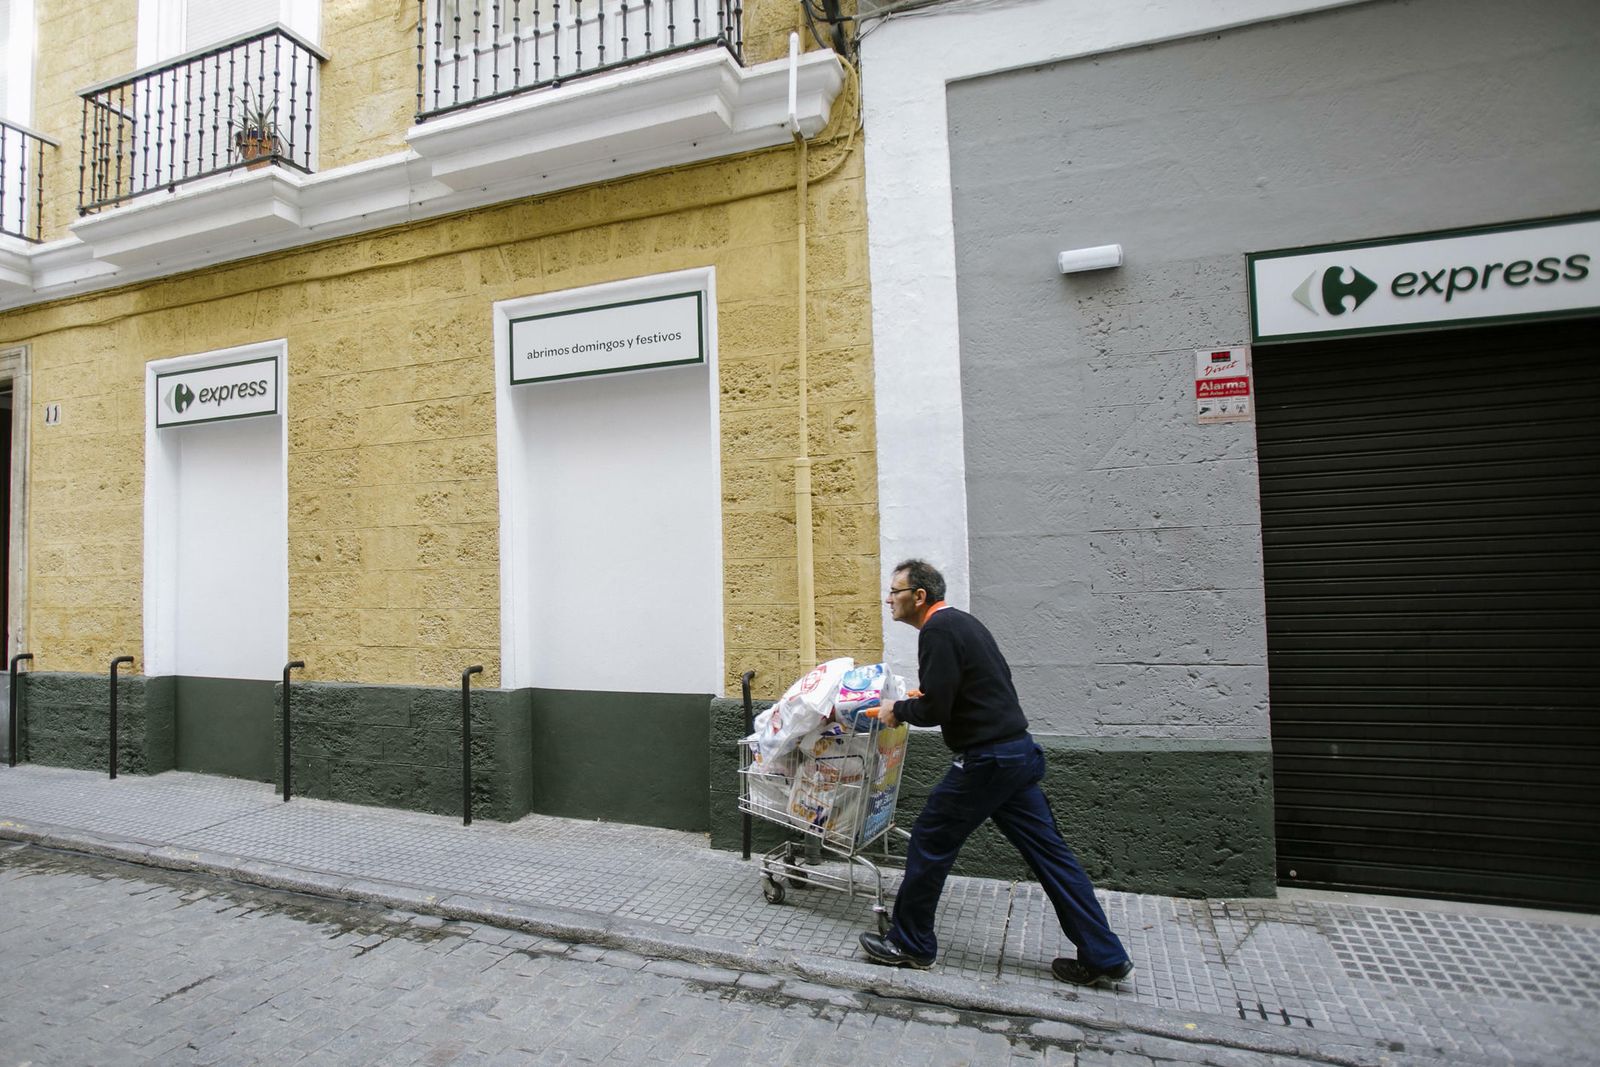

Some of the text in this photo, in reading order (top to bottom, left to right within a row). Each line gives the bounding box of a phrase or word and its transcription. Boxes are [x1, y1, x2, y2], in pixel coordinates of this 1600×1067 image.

[1391, 253, 1591, 302] express
[527, 331, 682, 359] abrimos domingos y festivos
[199, 380, 267, 406] express
[1199, 381, 1247, 391] Alarma
